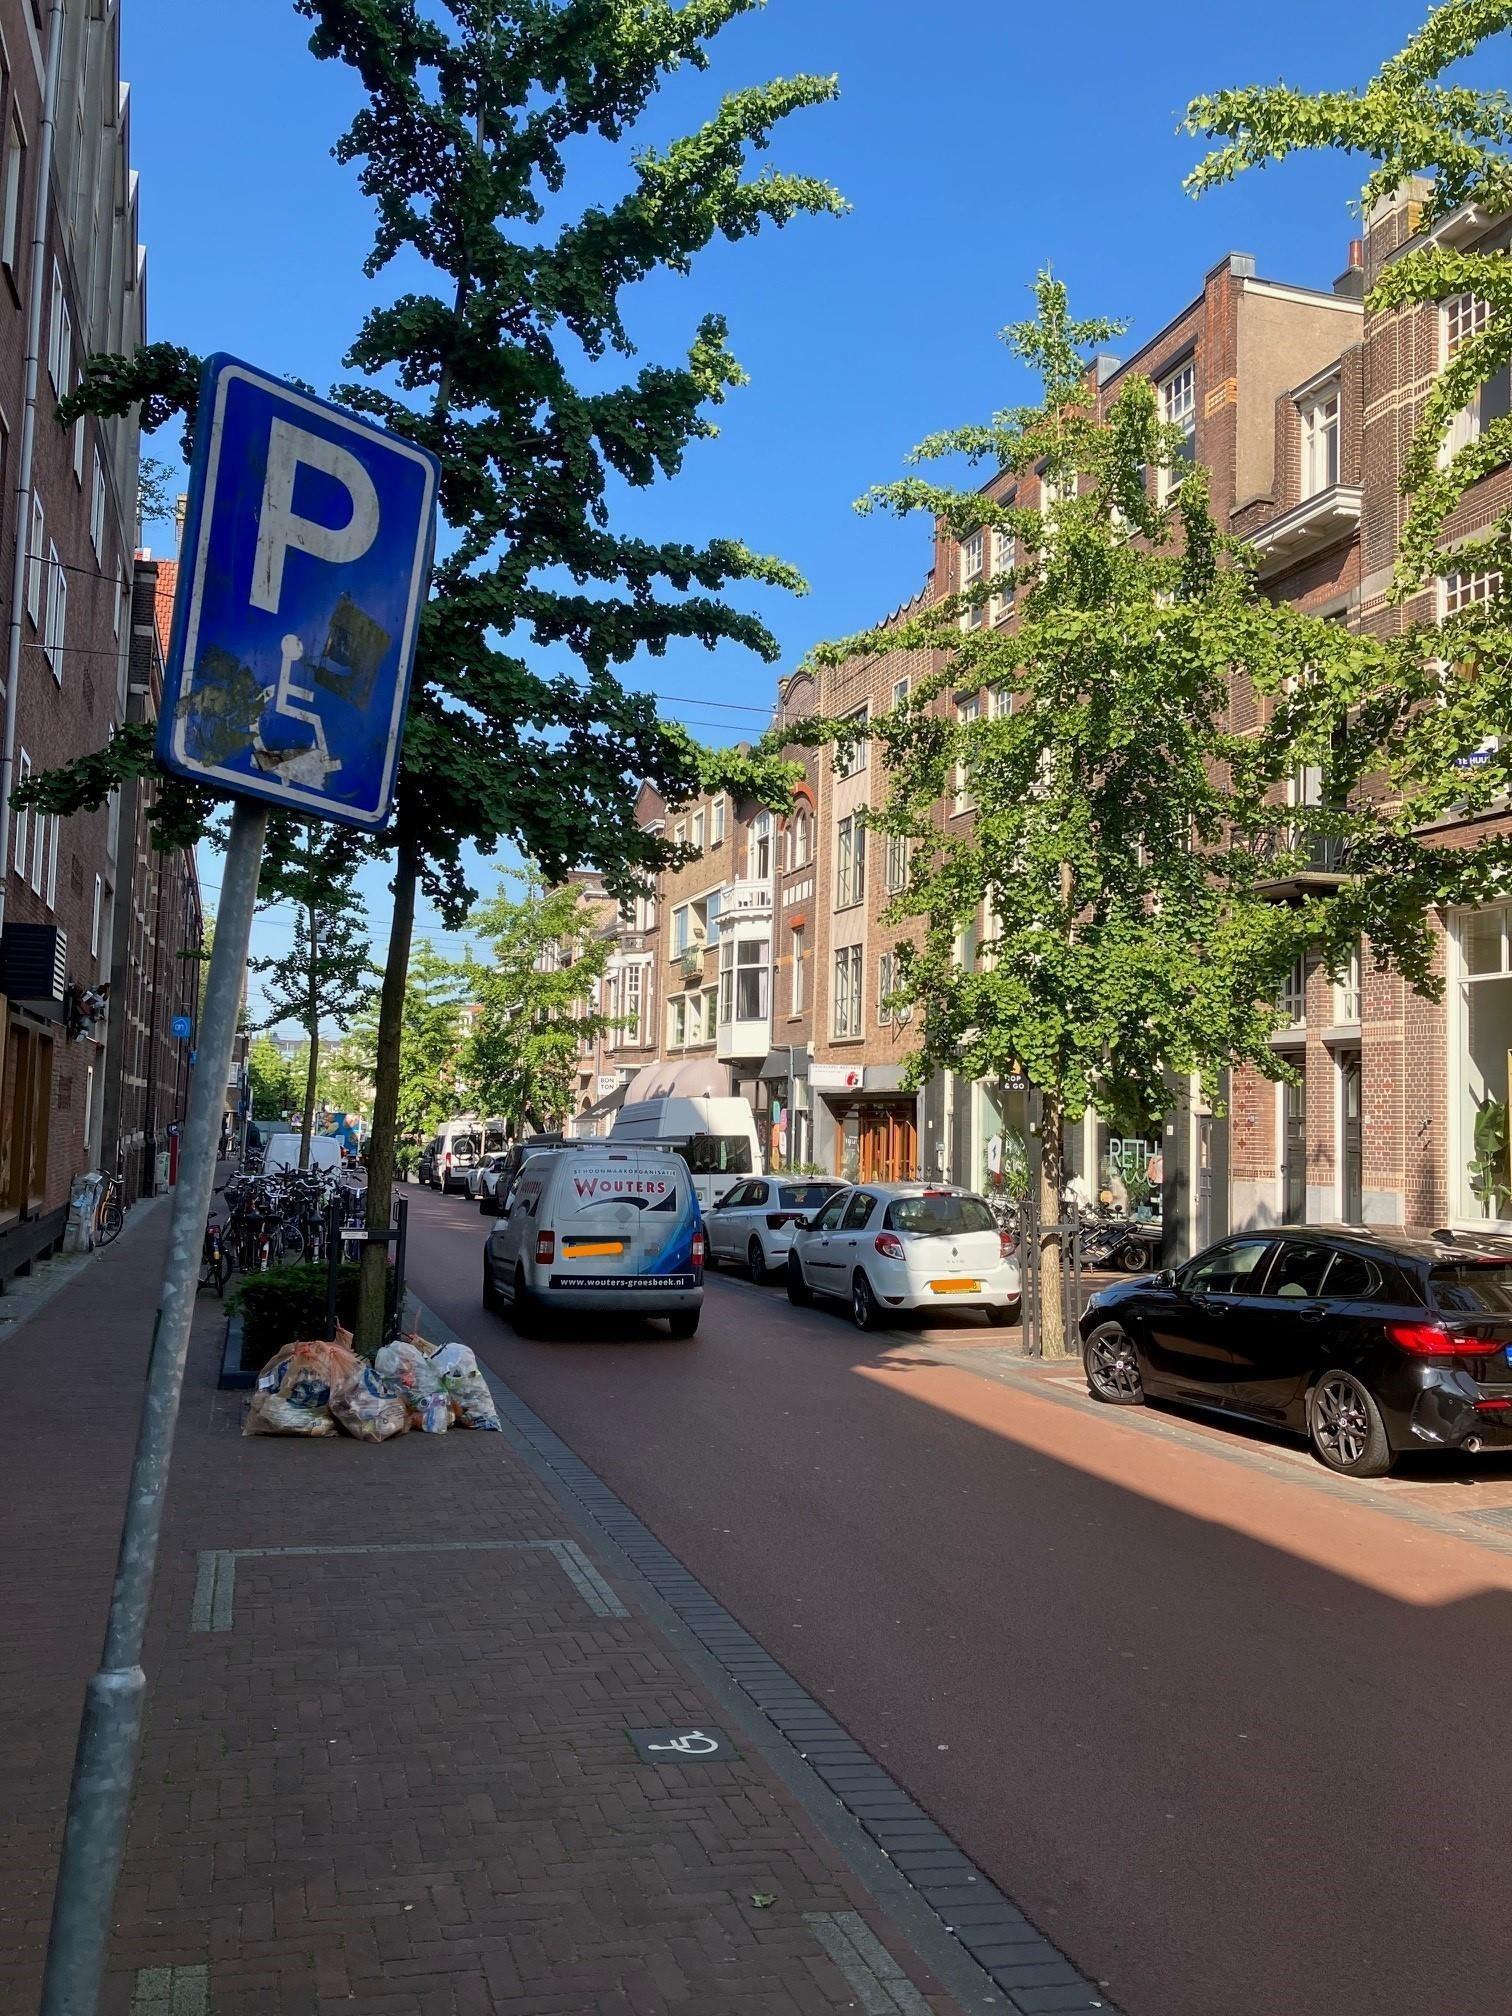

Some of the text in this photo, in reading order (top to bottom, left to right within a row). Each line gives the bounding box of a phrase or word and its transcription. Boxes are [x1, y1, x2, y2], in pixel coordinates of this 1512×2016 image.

[249, 416, 380, 614] P
[1469, 756, 1490, 765] HUU
[1004, 1082, 1025, 1090] & GO
[560, 1277, 684, 1288] www.wouters-groesbeek.nl
